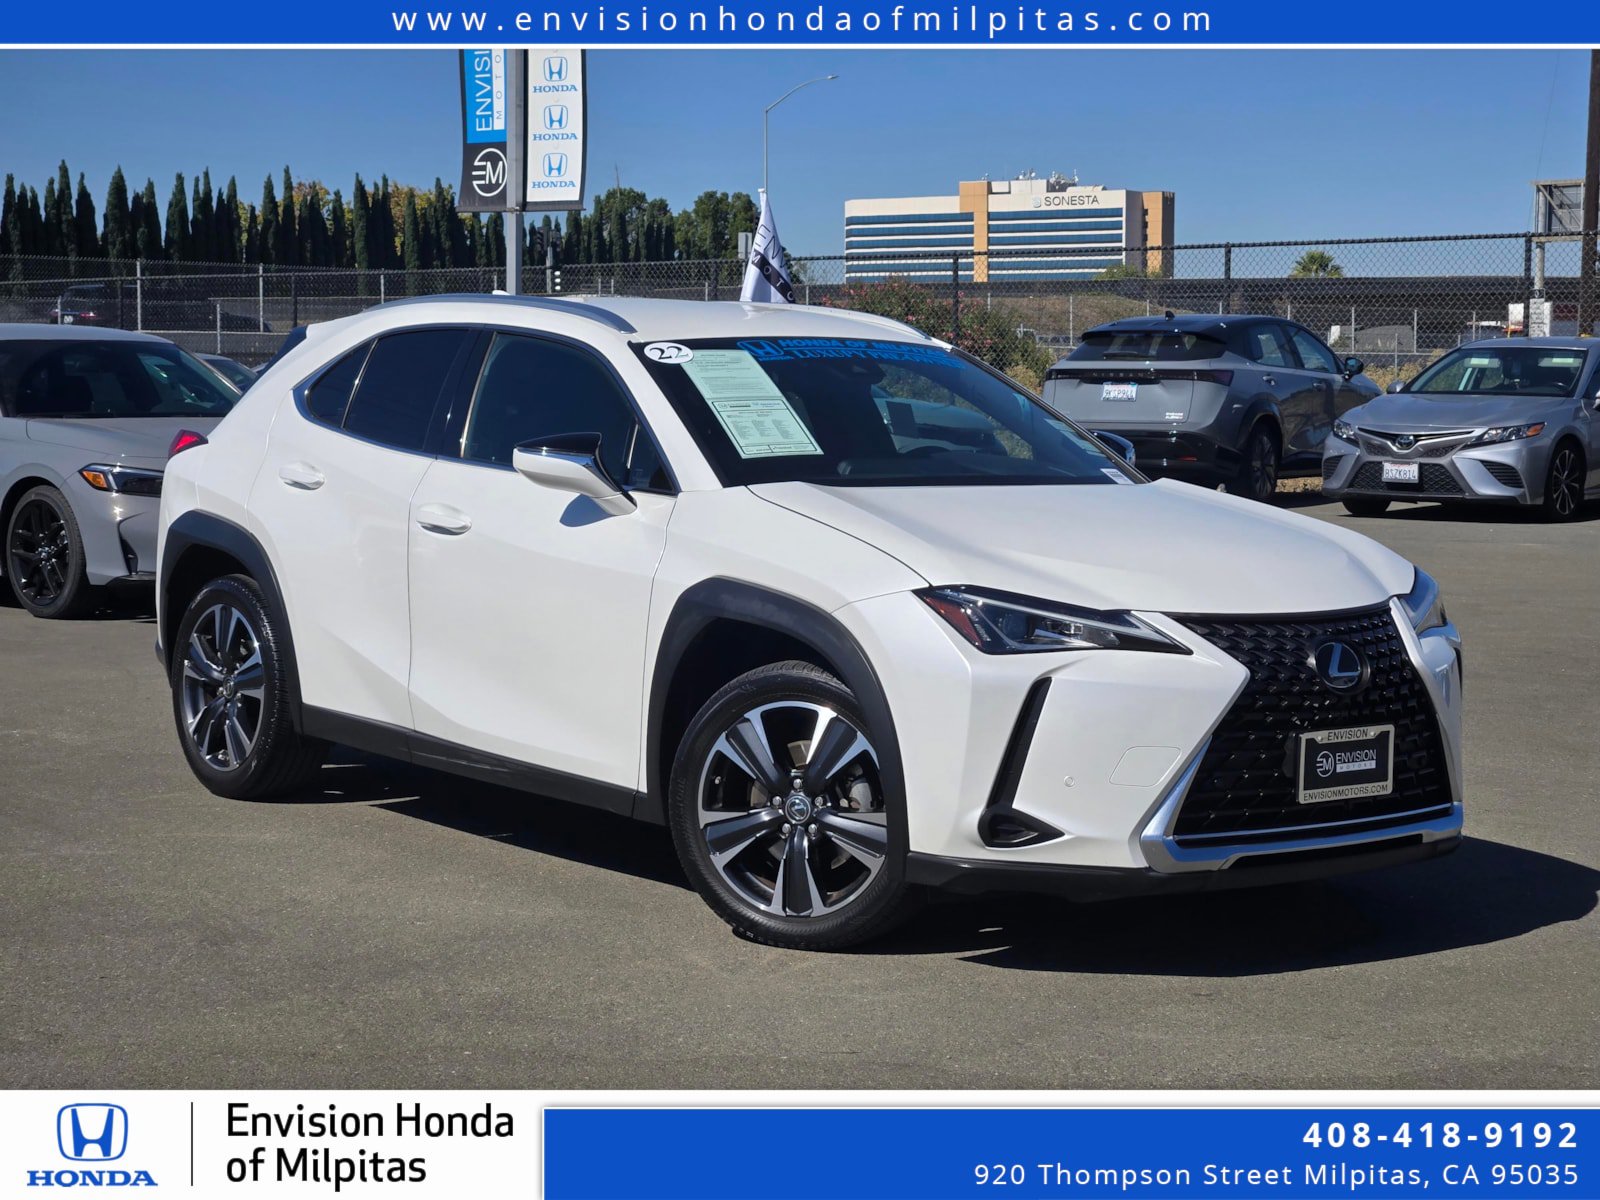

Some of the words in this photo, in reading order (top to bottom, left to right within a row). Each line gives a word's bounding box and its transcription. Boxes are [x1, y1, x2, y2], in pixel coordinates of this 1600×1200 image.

[533, 84, 578, 93] HONDA
[533, 132, 578, 141] HONDA
[531, 180, 576, 189] HONDA
[1044, 195, 1100, 207] SONESTA
[649, 345, 689, 360] 22
[1327, 728, 1368, 741] ENVISION
[1336, 749, 1377, 764] ENVISION
[1304, 784, 1388, 801] ENVISIONMOTORS.COM
